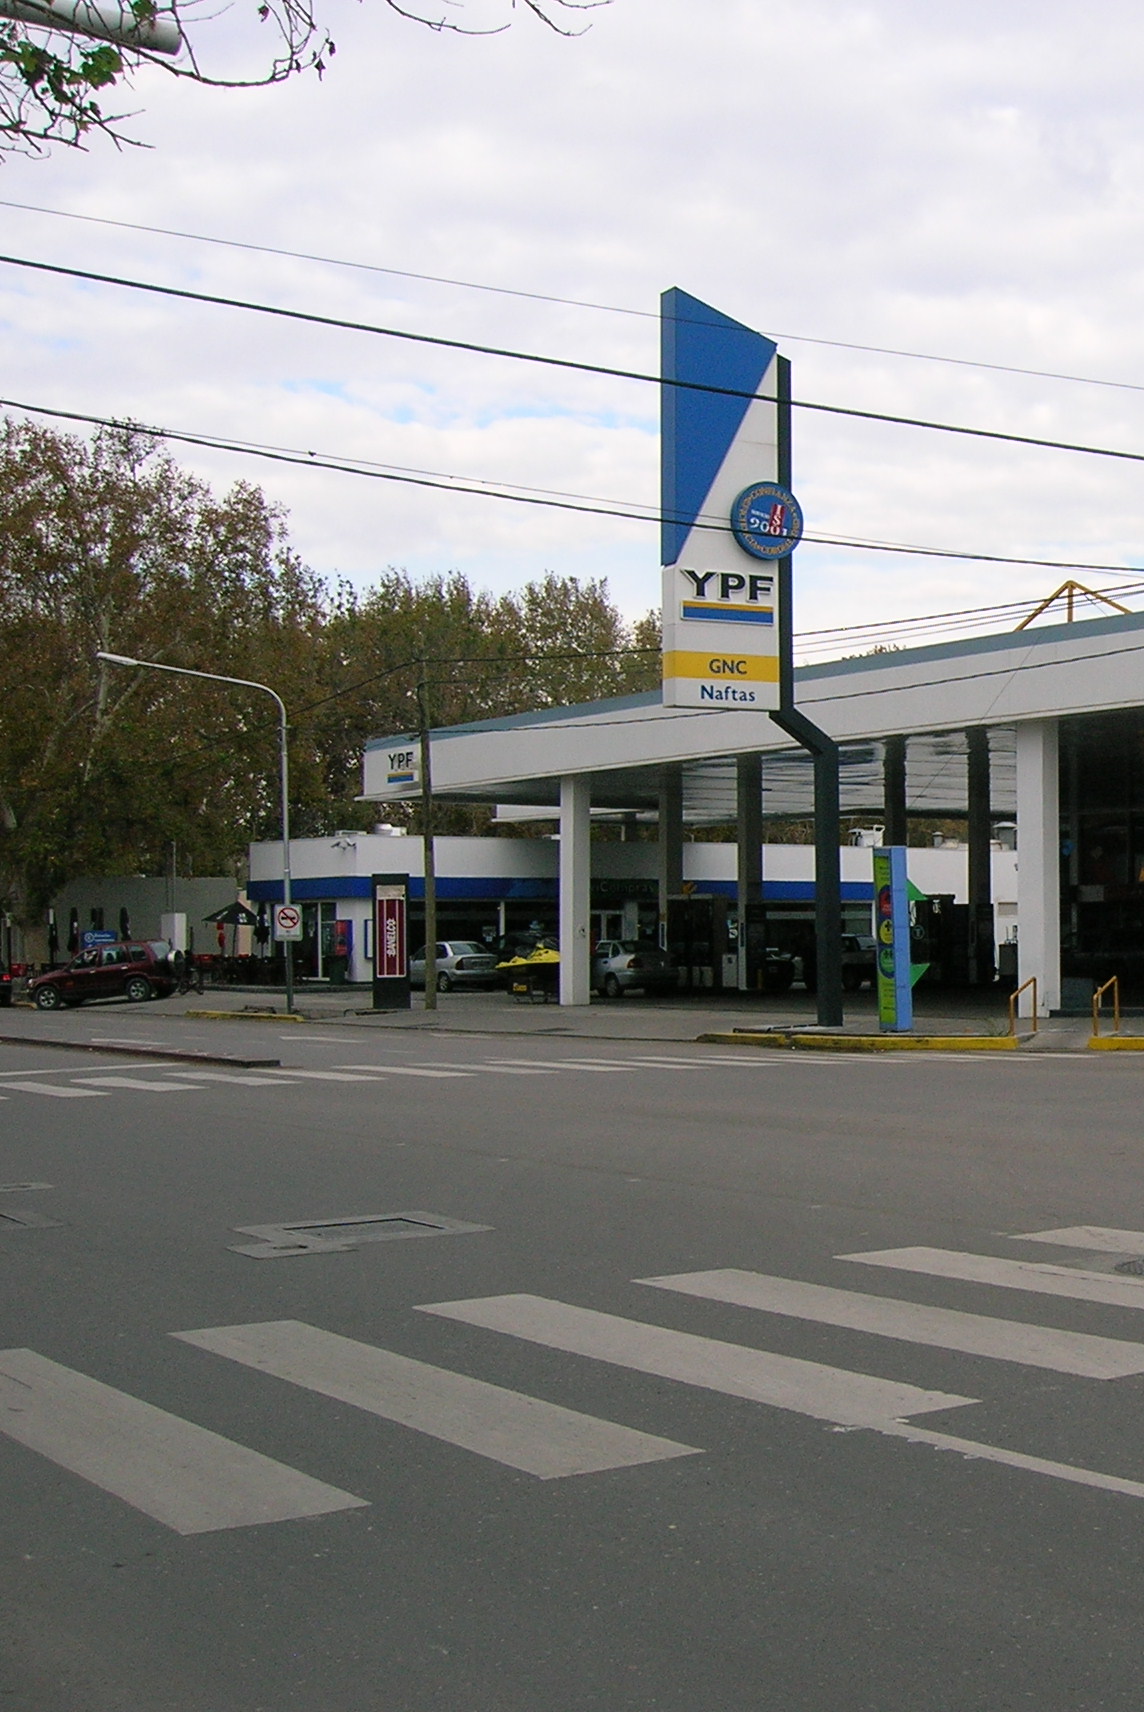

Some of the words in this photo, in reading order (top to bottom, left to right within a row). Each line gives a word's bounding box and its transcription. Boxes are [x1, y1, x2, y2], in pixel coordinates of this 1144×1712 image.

[682, 569, 774, 602] YPF
[709, 658, 748, 675] GNC
[700, 685, 756, 702] Naftas
[388, 751, 414, 770] YPF
[386, 918, 397, 956] BANELCO
